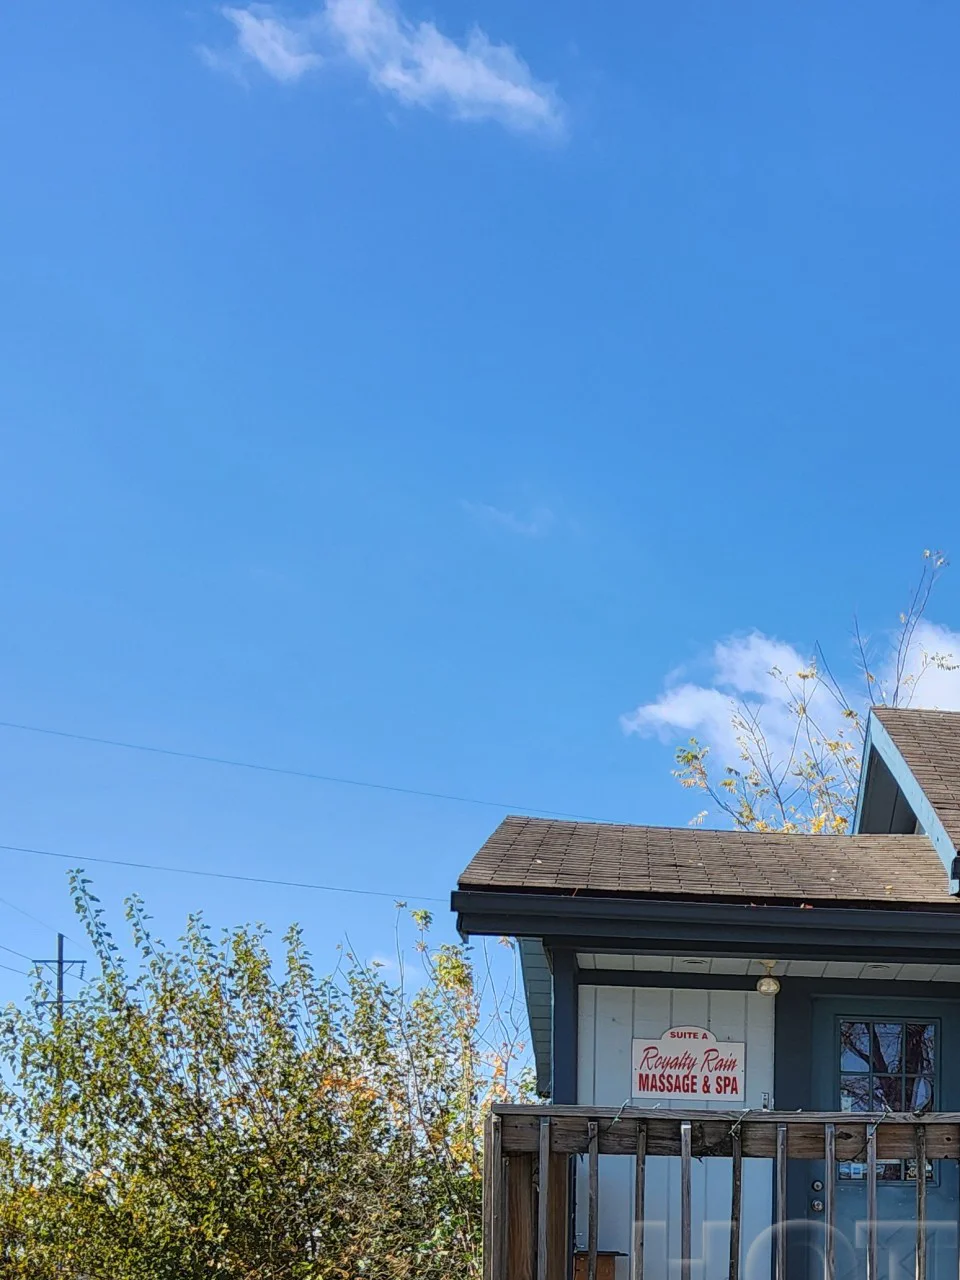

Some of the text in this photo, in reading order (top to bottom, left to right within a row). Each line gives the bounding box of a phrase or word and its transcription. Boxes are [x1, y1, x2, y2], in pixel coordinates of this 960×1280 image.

[670, 1031, 709, 1040] SUITE A
[640, 1046, 738, 1076] Royalty Rain
[638, 1073, 739, 1095] MASSAGE & SPA
